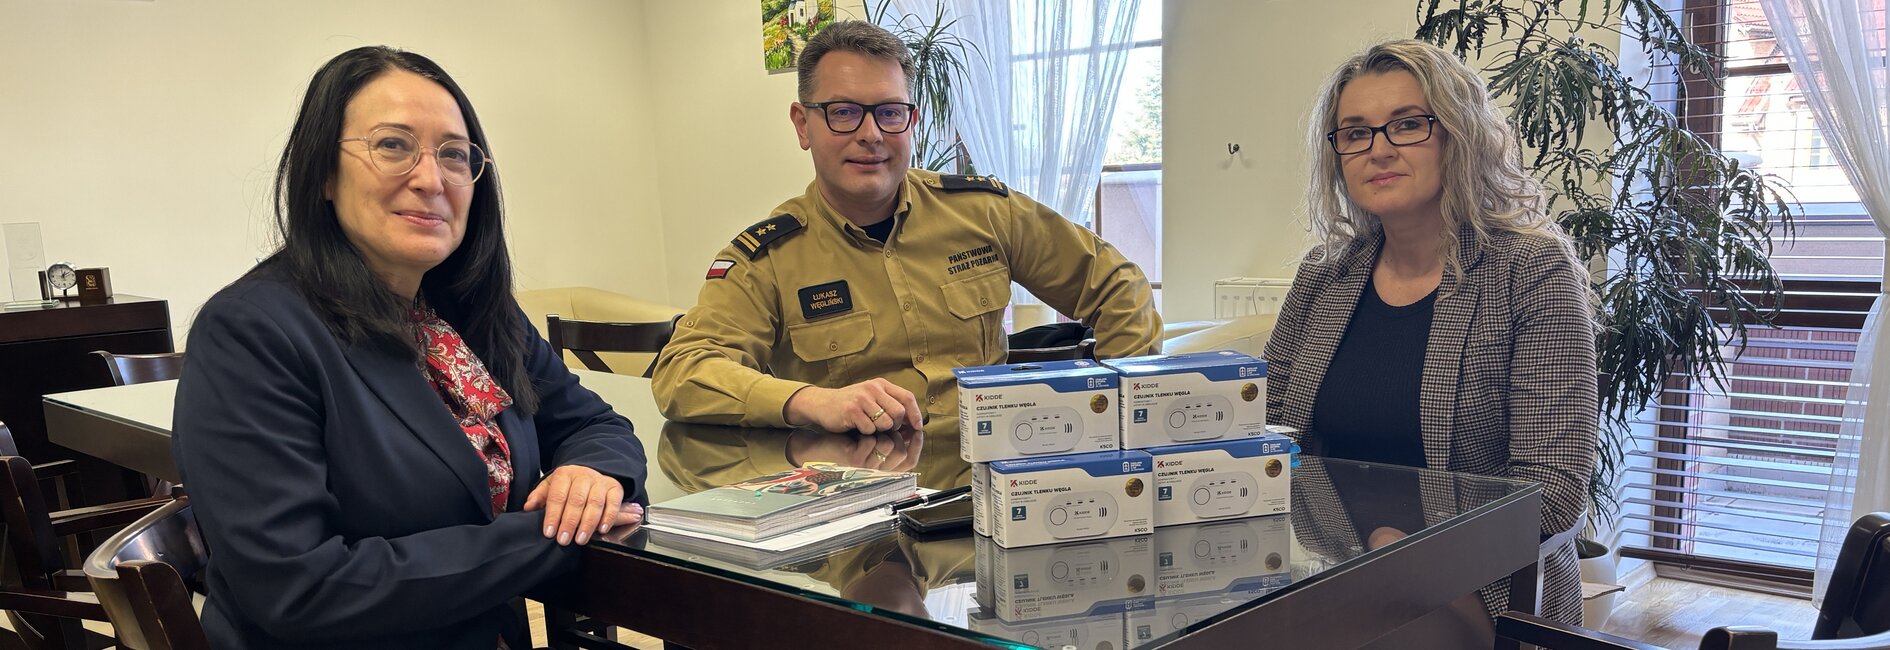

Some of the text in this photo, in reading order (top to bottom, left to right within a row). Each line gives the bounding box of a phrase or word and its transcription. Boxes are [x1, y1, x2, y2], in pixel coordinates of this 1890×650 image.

[948, 245, 992, 264] PAŃSTWOWA
[948, 262, 970, 274] STRAŻ
[812, 290, 837, 300] ŁUKASZ
[810, 297, 844, 310] WĘGLIŃSKI
